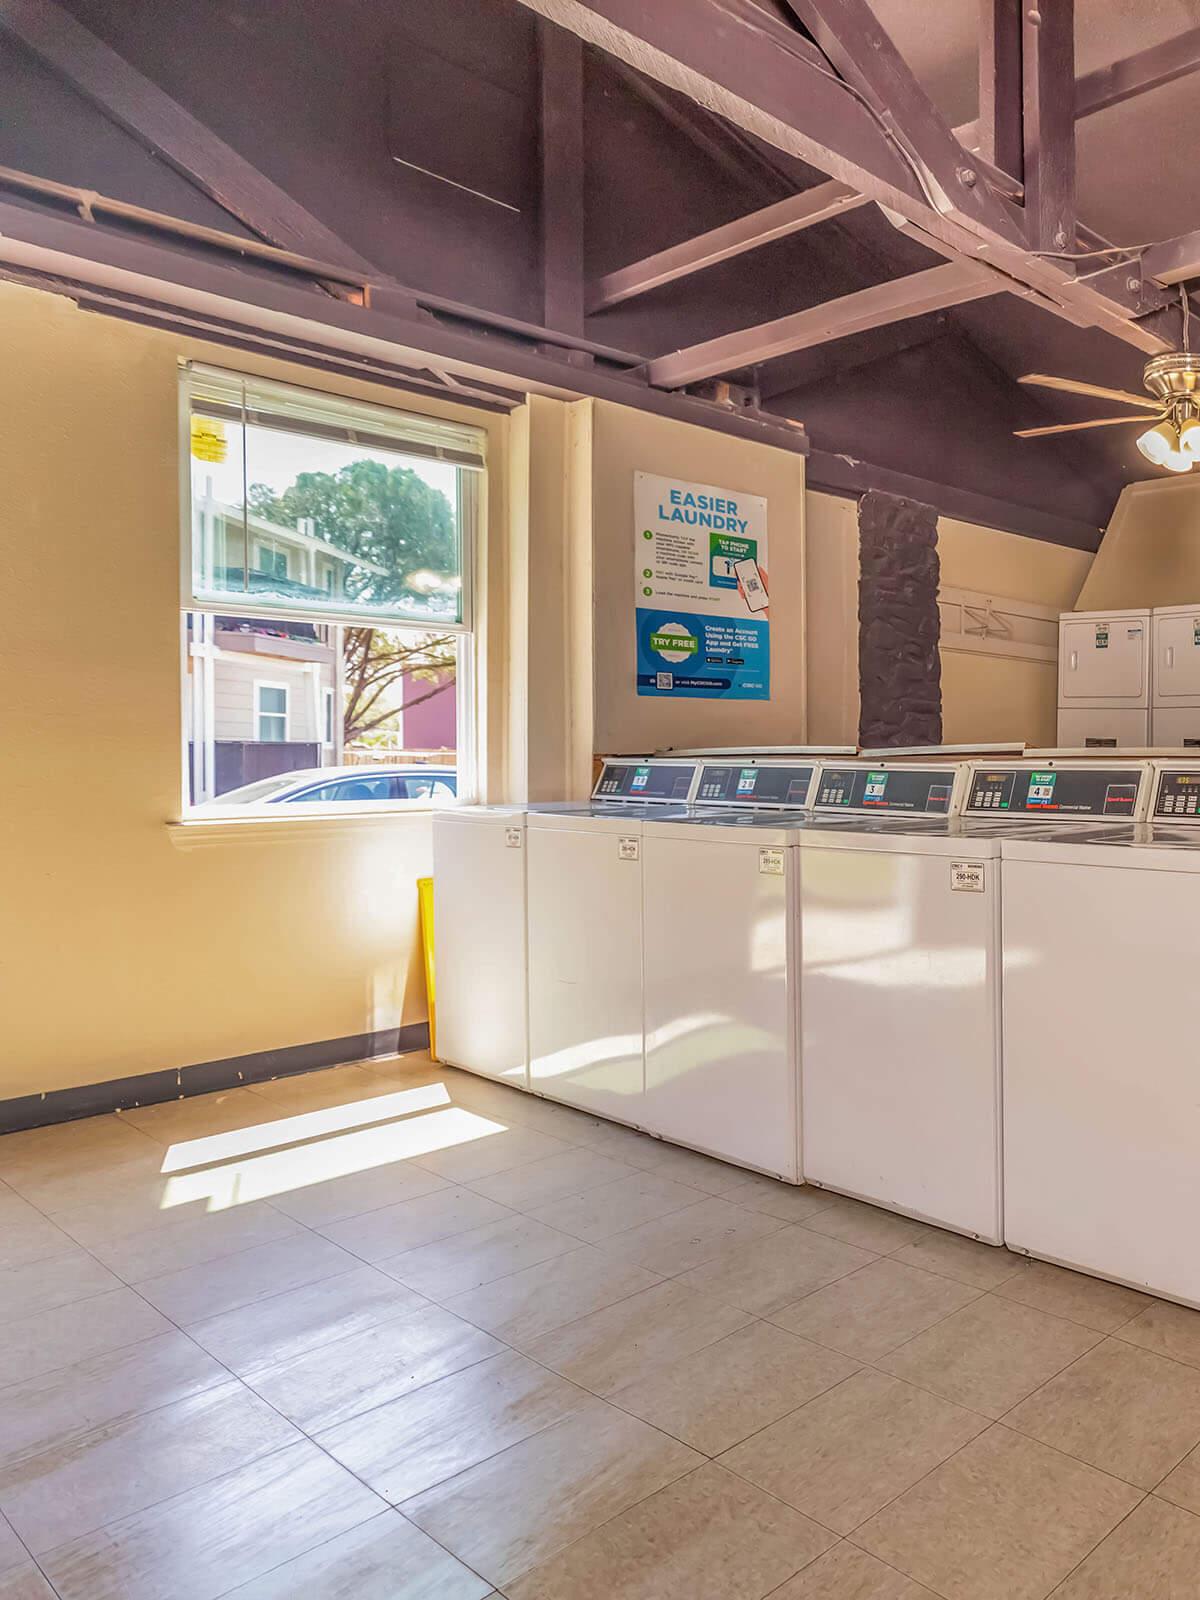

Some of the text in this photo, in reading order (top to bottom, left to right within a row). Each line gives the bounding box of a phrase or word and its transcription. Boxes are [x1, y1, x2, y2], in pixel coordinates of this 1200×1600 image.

[670, 489, 738, 516] EASIER
[658, 504, 749, 533] LAUNDRY
[705, 625, 725, 633] Create
[652, 637, 695, 649] TRY FREE
[870, 785, 876, 794] 3
[1033, 786, 1041, 797] 4
[956, 872, 980, 881] 290-HDK
